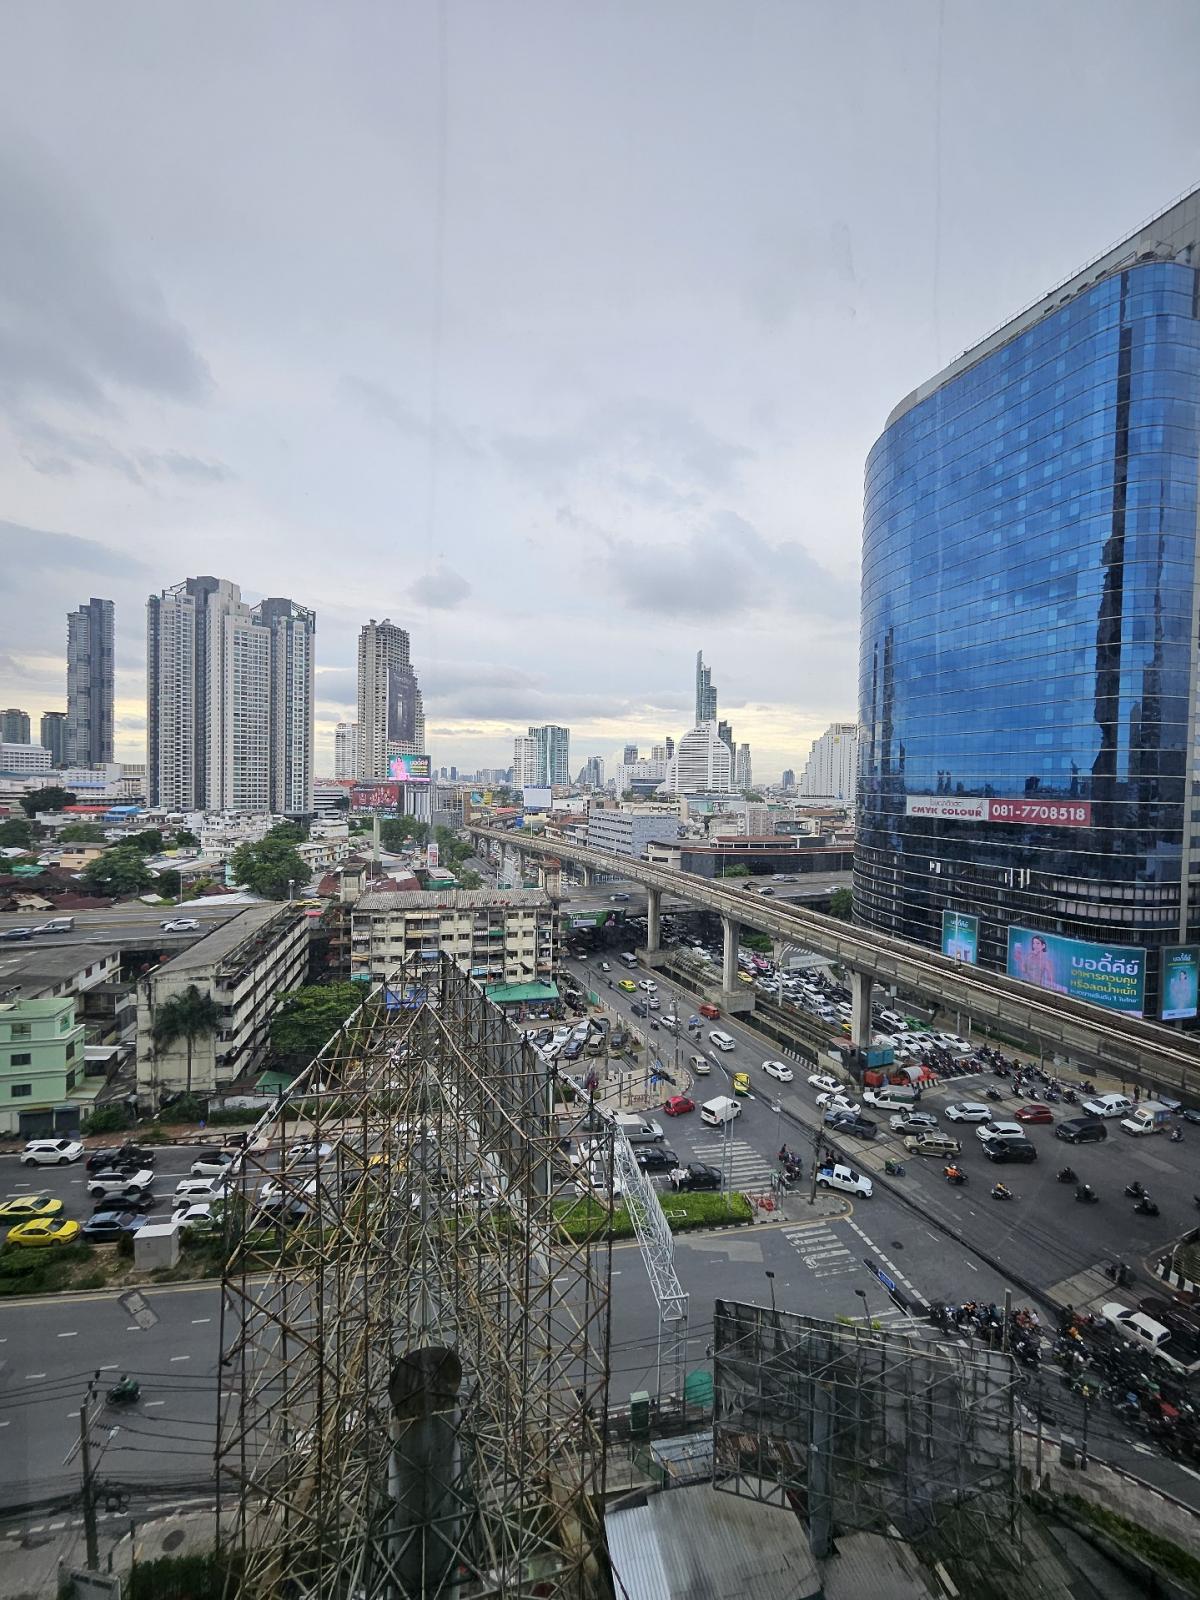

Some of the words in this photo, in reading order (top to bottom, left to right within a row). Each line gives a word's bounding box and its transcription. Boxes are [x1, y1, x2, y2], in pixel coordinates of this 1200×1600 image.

[911, 806, 938, 815] CMYK
[941, 807, 982, 817] COLOUR
[992, 804, 1086, 821] 081-7708518
[1072, 952, 1139, 976] บอดี้คีย์
